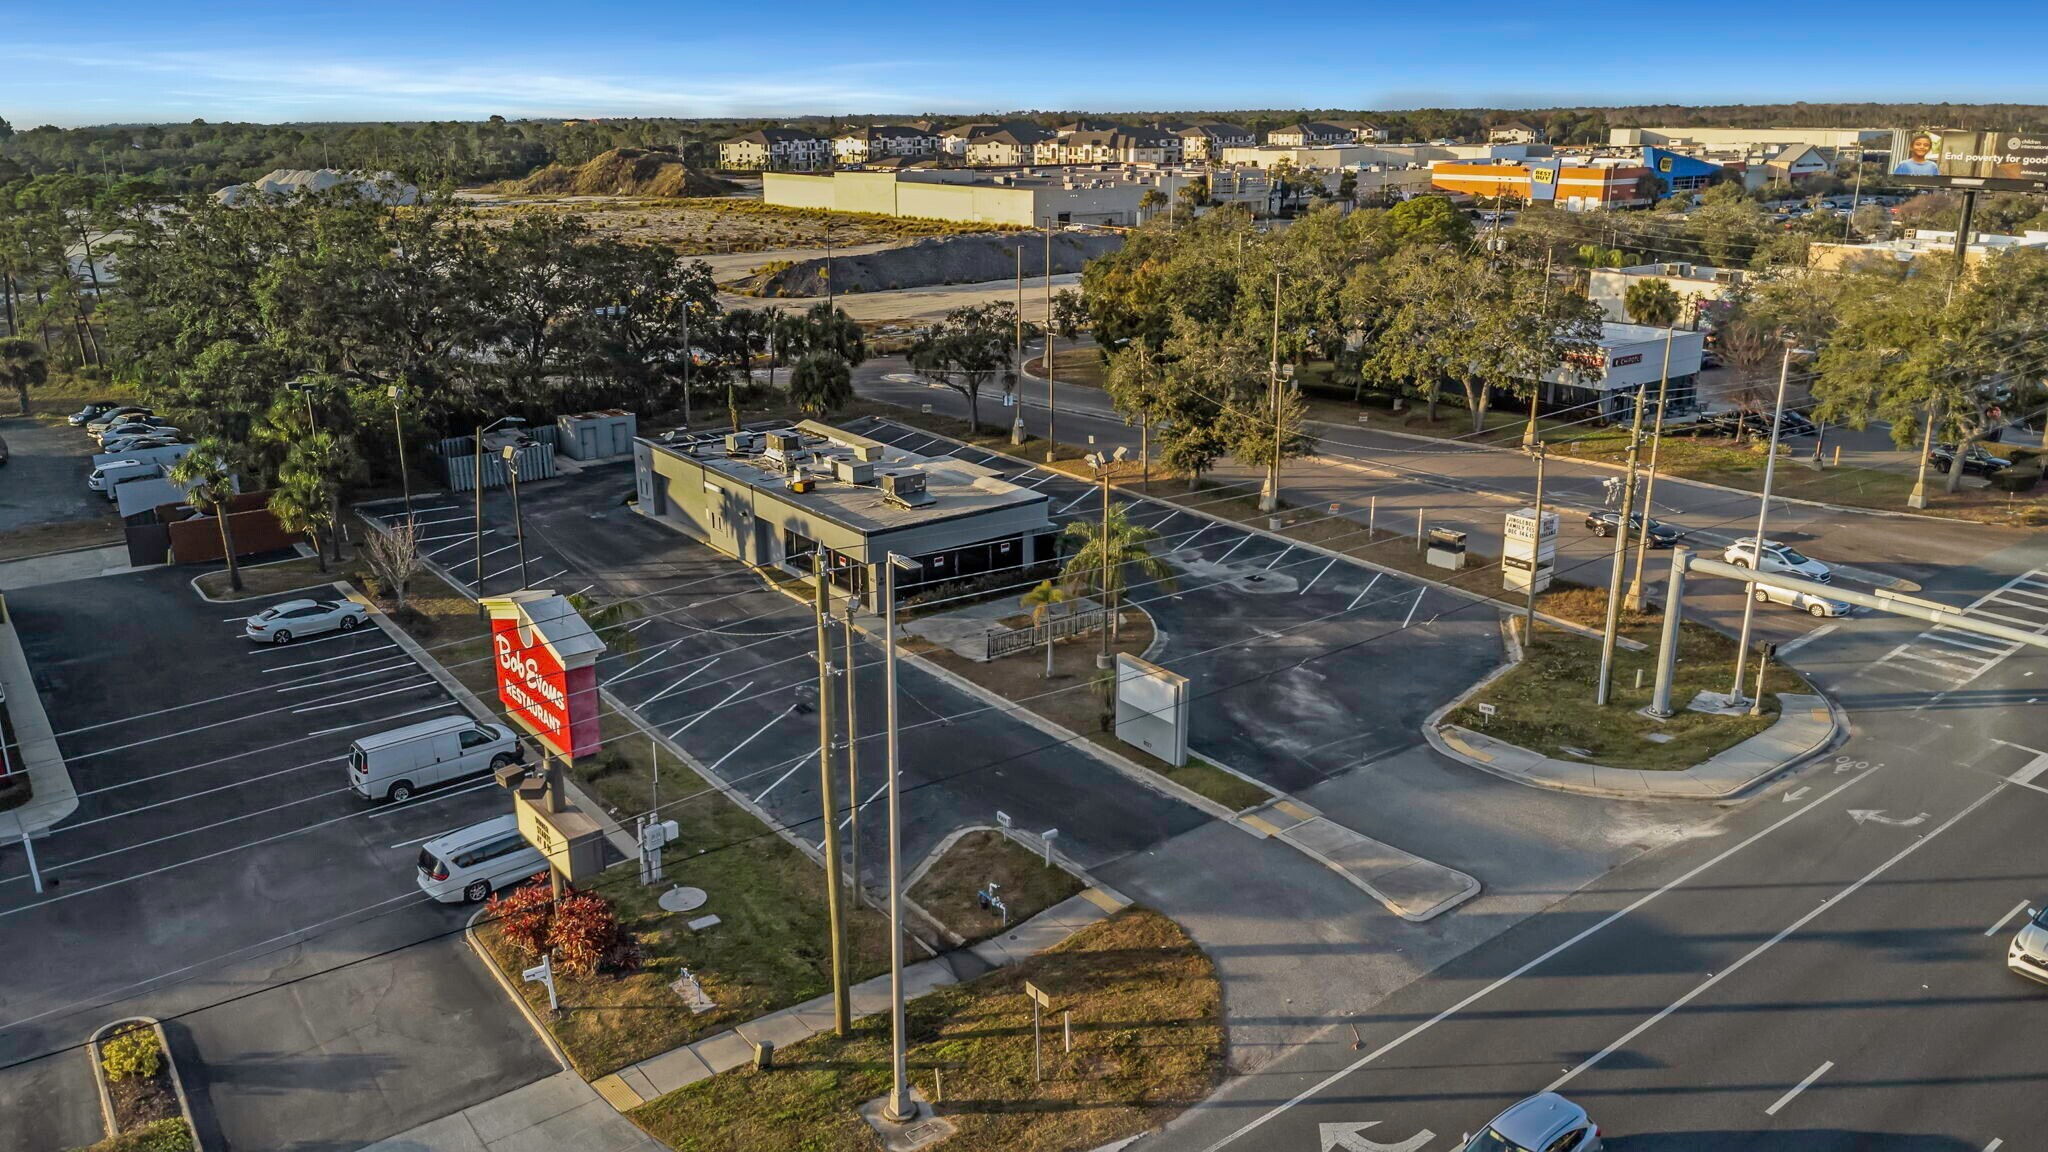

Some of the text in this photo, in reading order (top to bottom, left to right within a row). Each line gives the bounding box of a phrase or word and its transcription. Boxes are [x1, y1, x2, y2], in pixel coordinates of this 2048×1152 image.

[1945, 152, 2048, 165] End poverty for good
[1506, 522, 1525, 530] FAMILY
[495, 633, 566, 711] Bob Evans
[505, 678, 561, 736] RESTAURANT
[537, 825, 551, 845] STARTS
